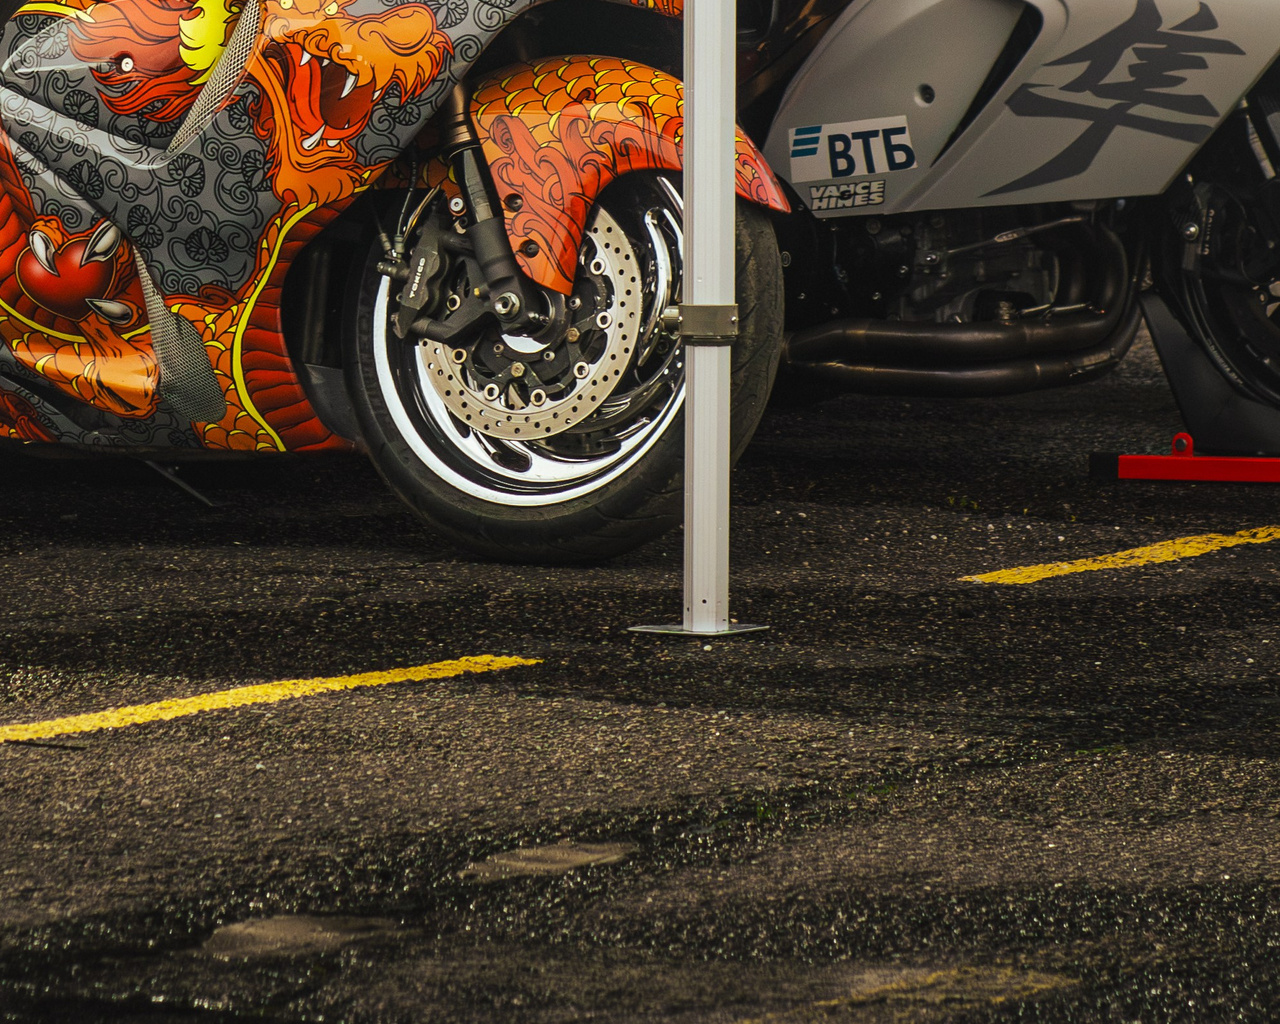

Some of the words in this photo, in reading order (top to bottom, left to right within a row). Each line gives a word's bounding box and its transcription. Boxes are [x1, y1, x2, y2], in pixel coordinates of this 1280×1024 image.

[827, 126, 917, 177] ВТБ
[809, 180, 886, 198] VANCE
[811, 192, 885, 211] HINES
[409, 257, 426, 299] TOKICO
